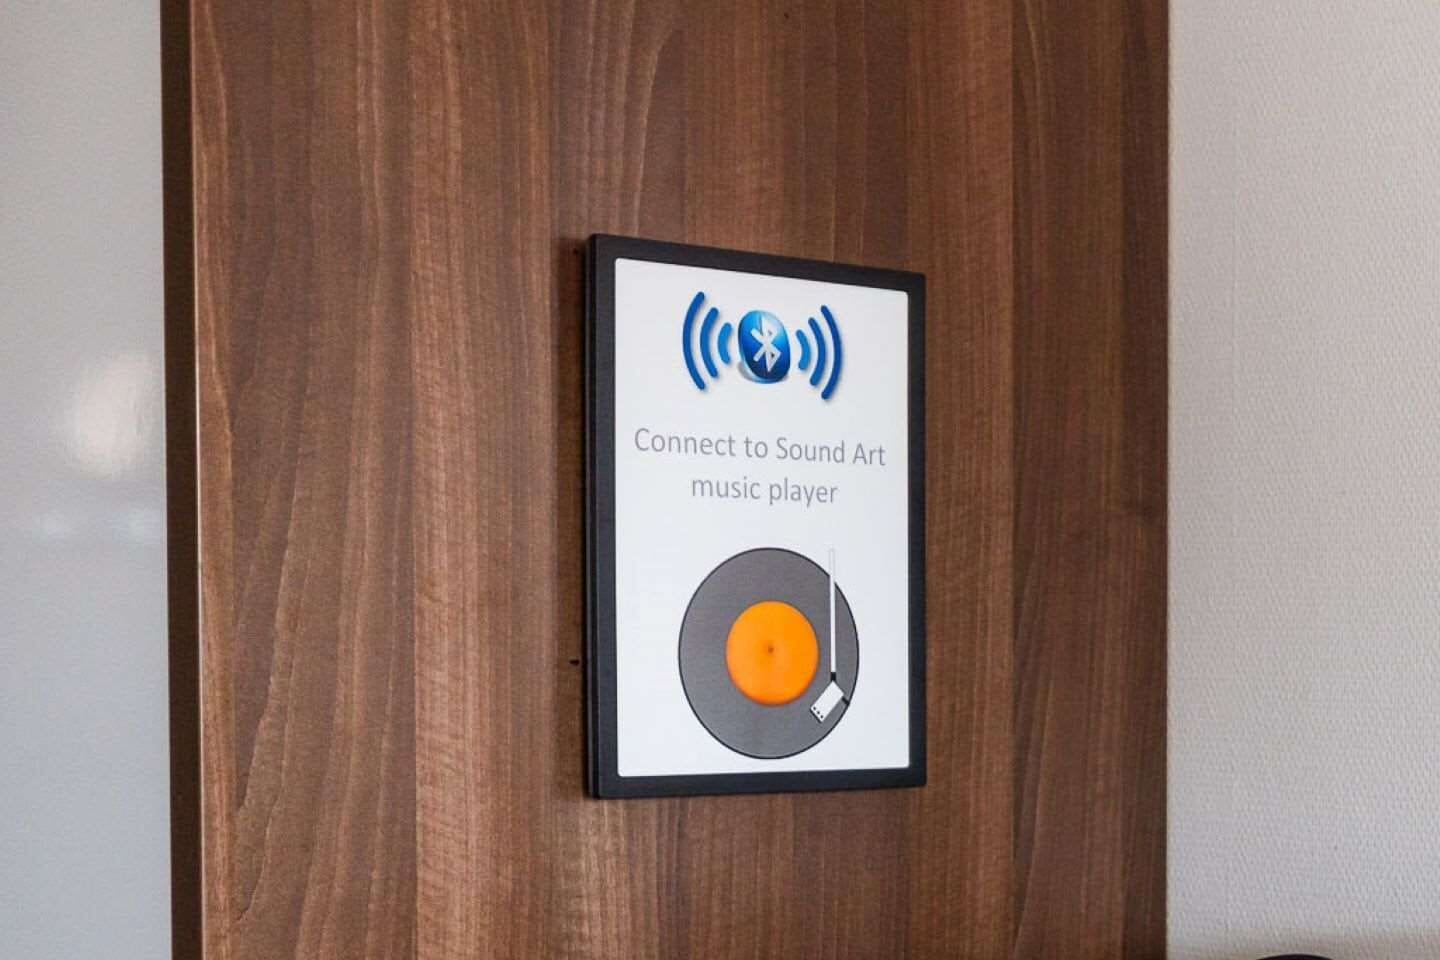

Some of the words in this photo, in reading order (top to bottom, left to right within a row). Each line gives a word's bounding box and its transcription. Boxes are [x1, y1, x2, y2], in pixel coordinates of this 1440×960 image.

[635, 428, 735, 456] Connect
[744, 437, 768, 458] to
[777, 438, 844, 463] Sound
[853, 443, 885, 466] Art
[693, 476, 760, 499] music
[770, 478, 837, 507] player
